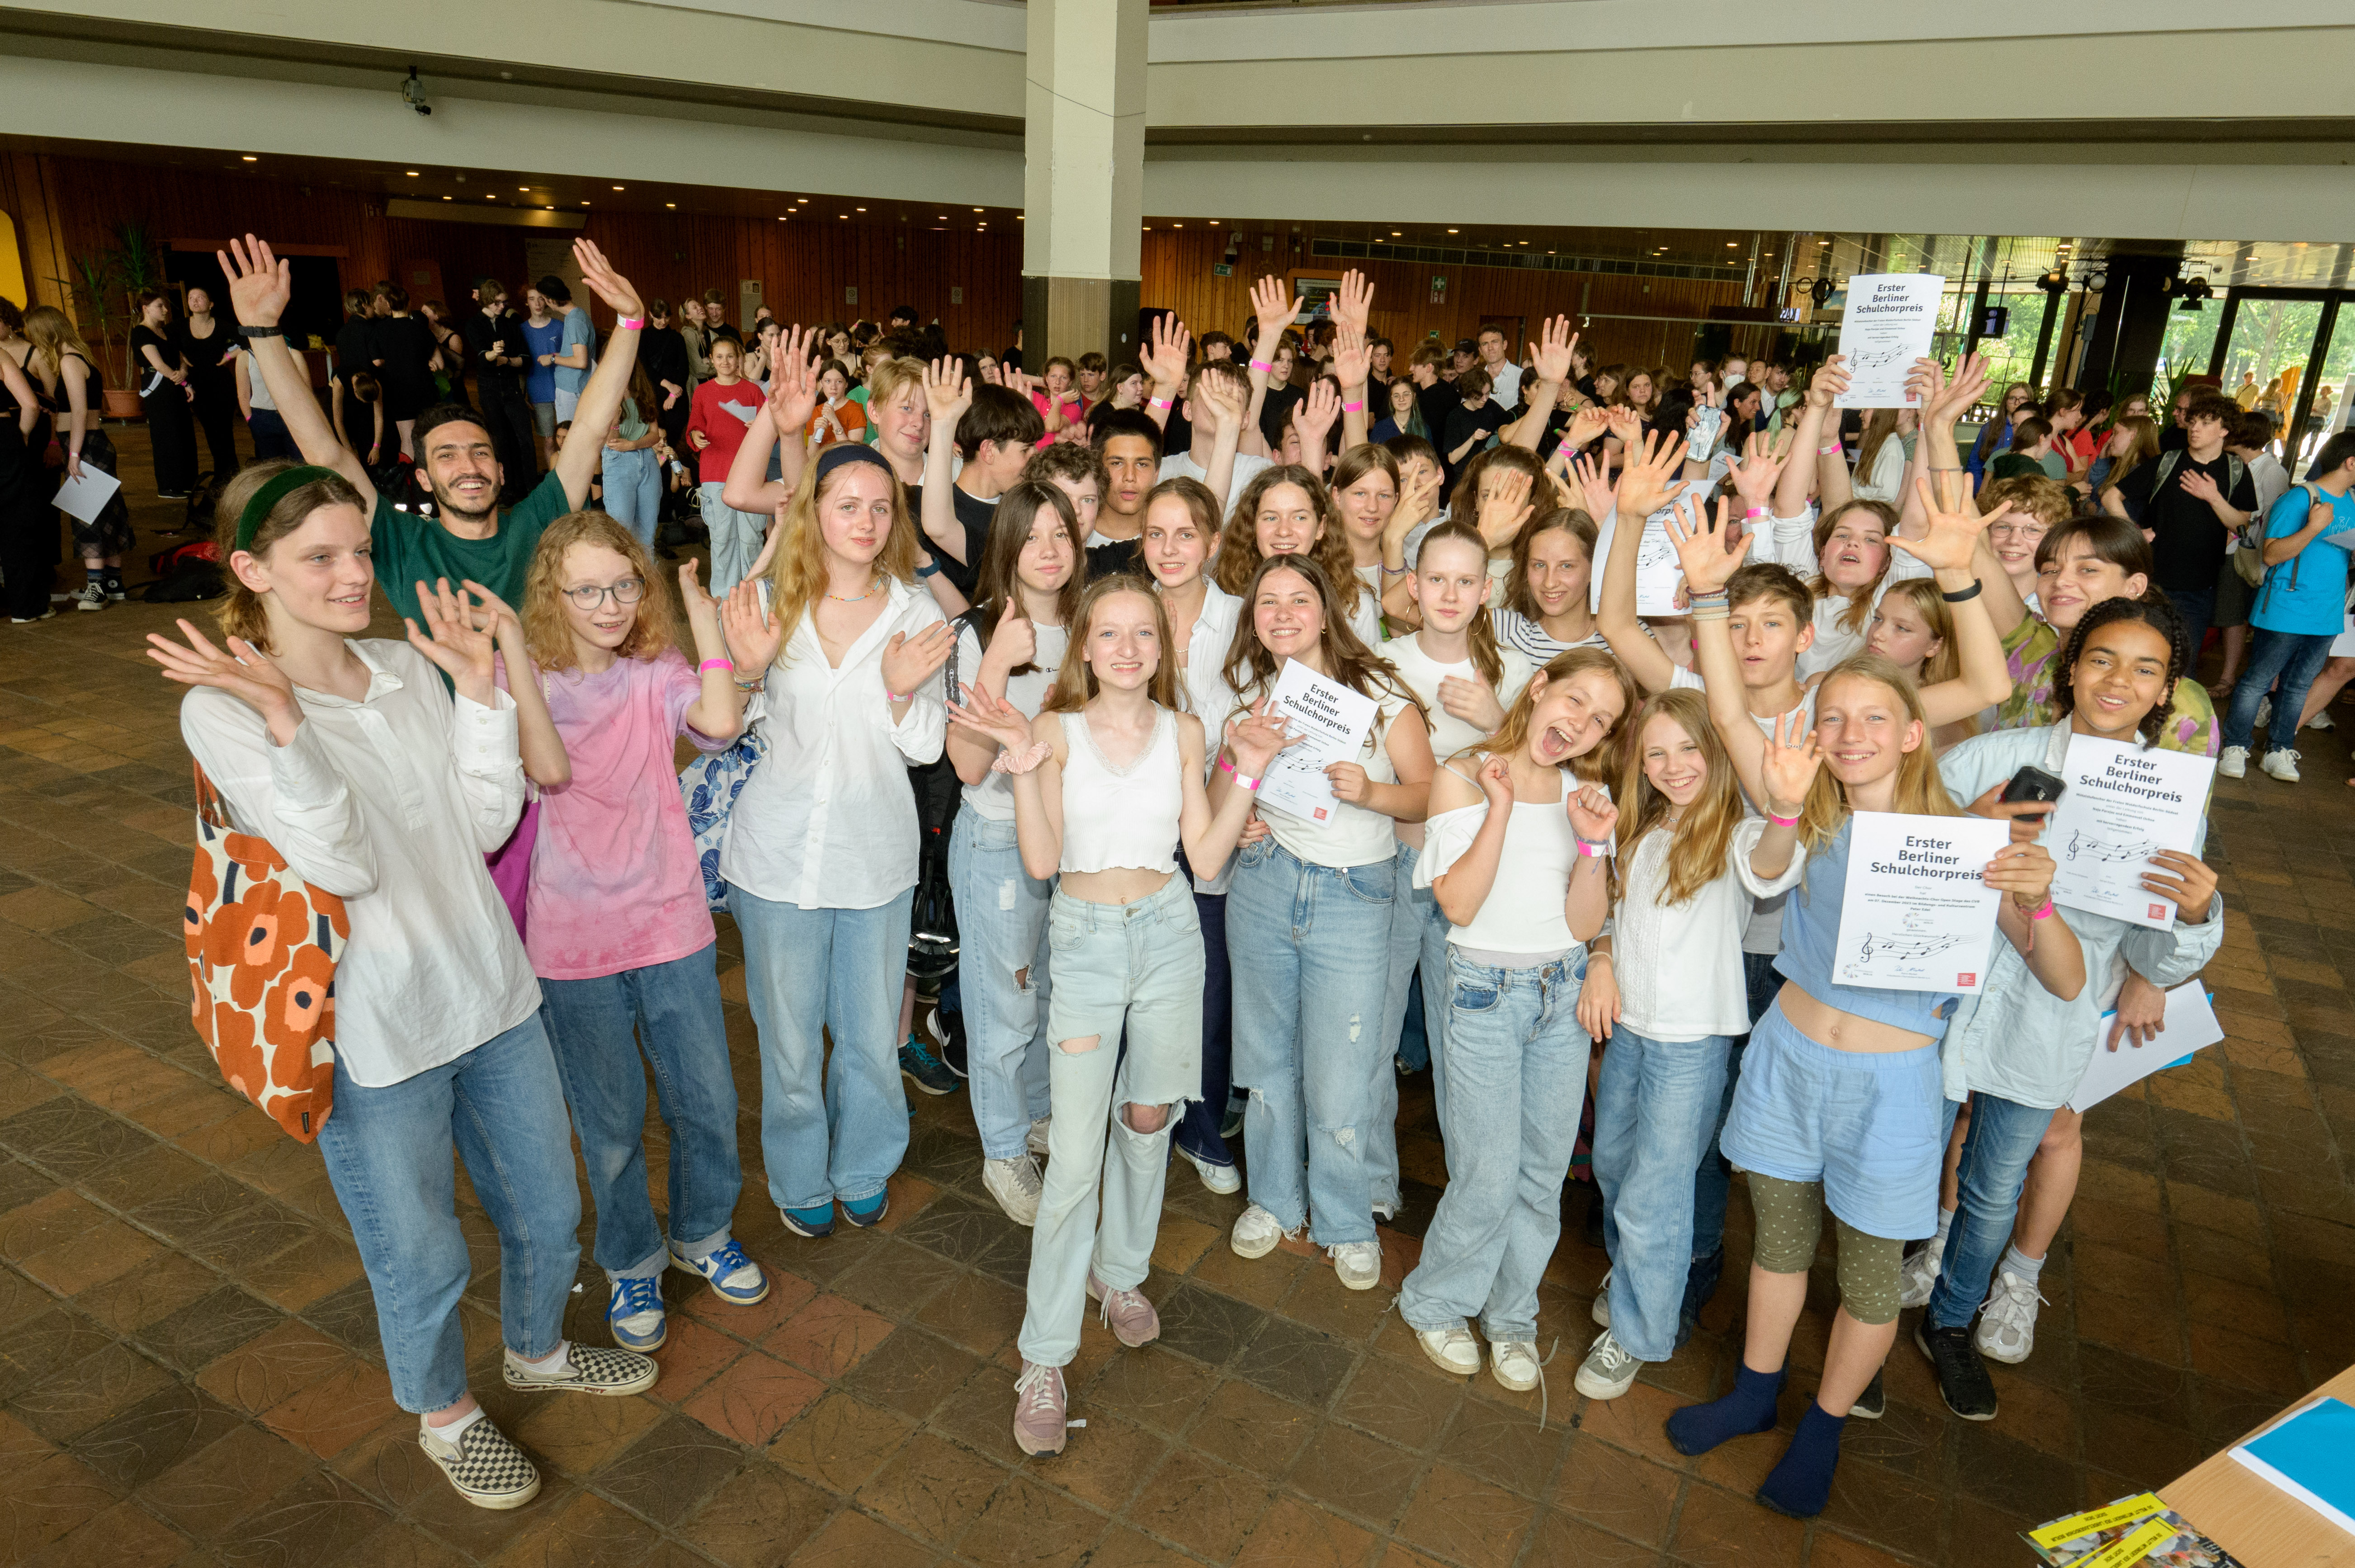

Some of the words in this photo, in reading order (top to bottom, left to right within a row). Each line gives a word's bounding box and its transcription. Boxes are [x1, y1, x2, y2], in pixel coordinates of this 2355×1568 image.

[1856, 304, 1923, 313] Schulchorpreis
[1310, 684, 1339, 704] Erster
[1284, 695, 1351, 734] Schulchorpreis
[1303, 693, 1340, 717] Berliner
[2115, 754, 2157, 770] Erster
[2106, 766, 2162, 785] Berliner
[2080, 775, 2182, 803] Schulchorpreis
[1906, 836, 1952, 850] Erster
[1898, 850, 1960, 865] Berliner
[1871, 862, 1982, 881] Schulchorpreis
